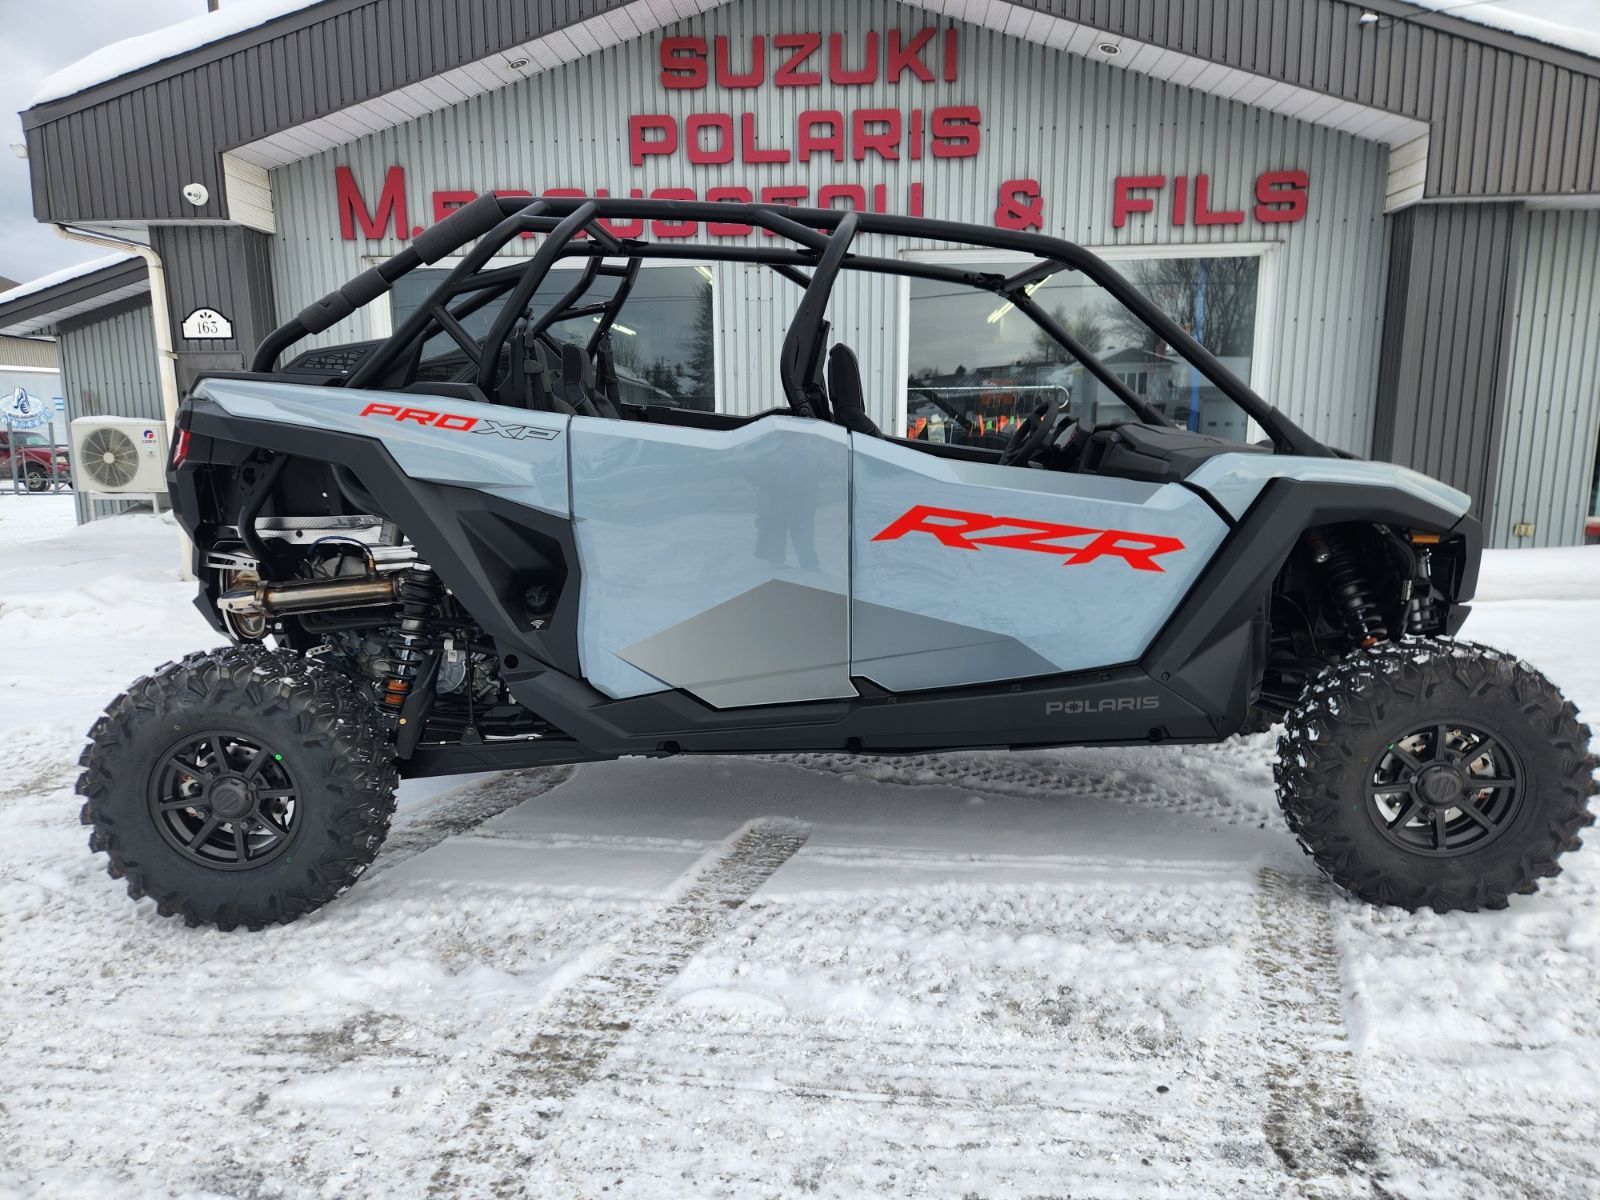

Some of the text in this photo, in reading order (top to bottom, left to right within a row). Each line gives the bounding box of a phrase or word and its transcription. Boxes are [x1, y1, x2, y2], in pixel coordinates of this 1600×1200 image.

[660, 27, 957, 90] SUZUKI
[630, 106, 981, 166] POLARIS
[995, 179, 1044, 230] &
[1112, 169, 1309, 229] FILS
[197, 320, 218, 335] 163
[360, 403, 561, 441] PRO XP
[870, 504, 1186, 573] RZR
[1045, 696, 1160, 715] POLARIS
